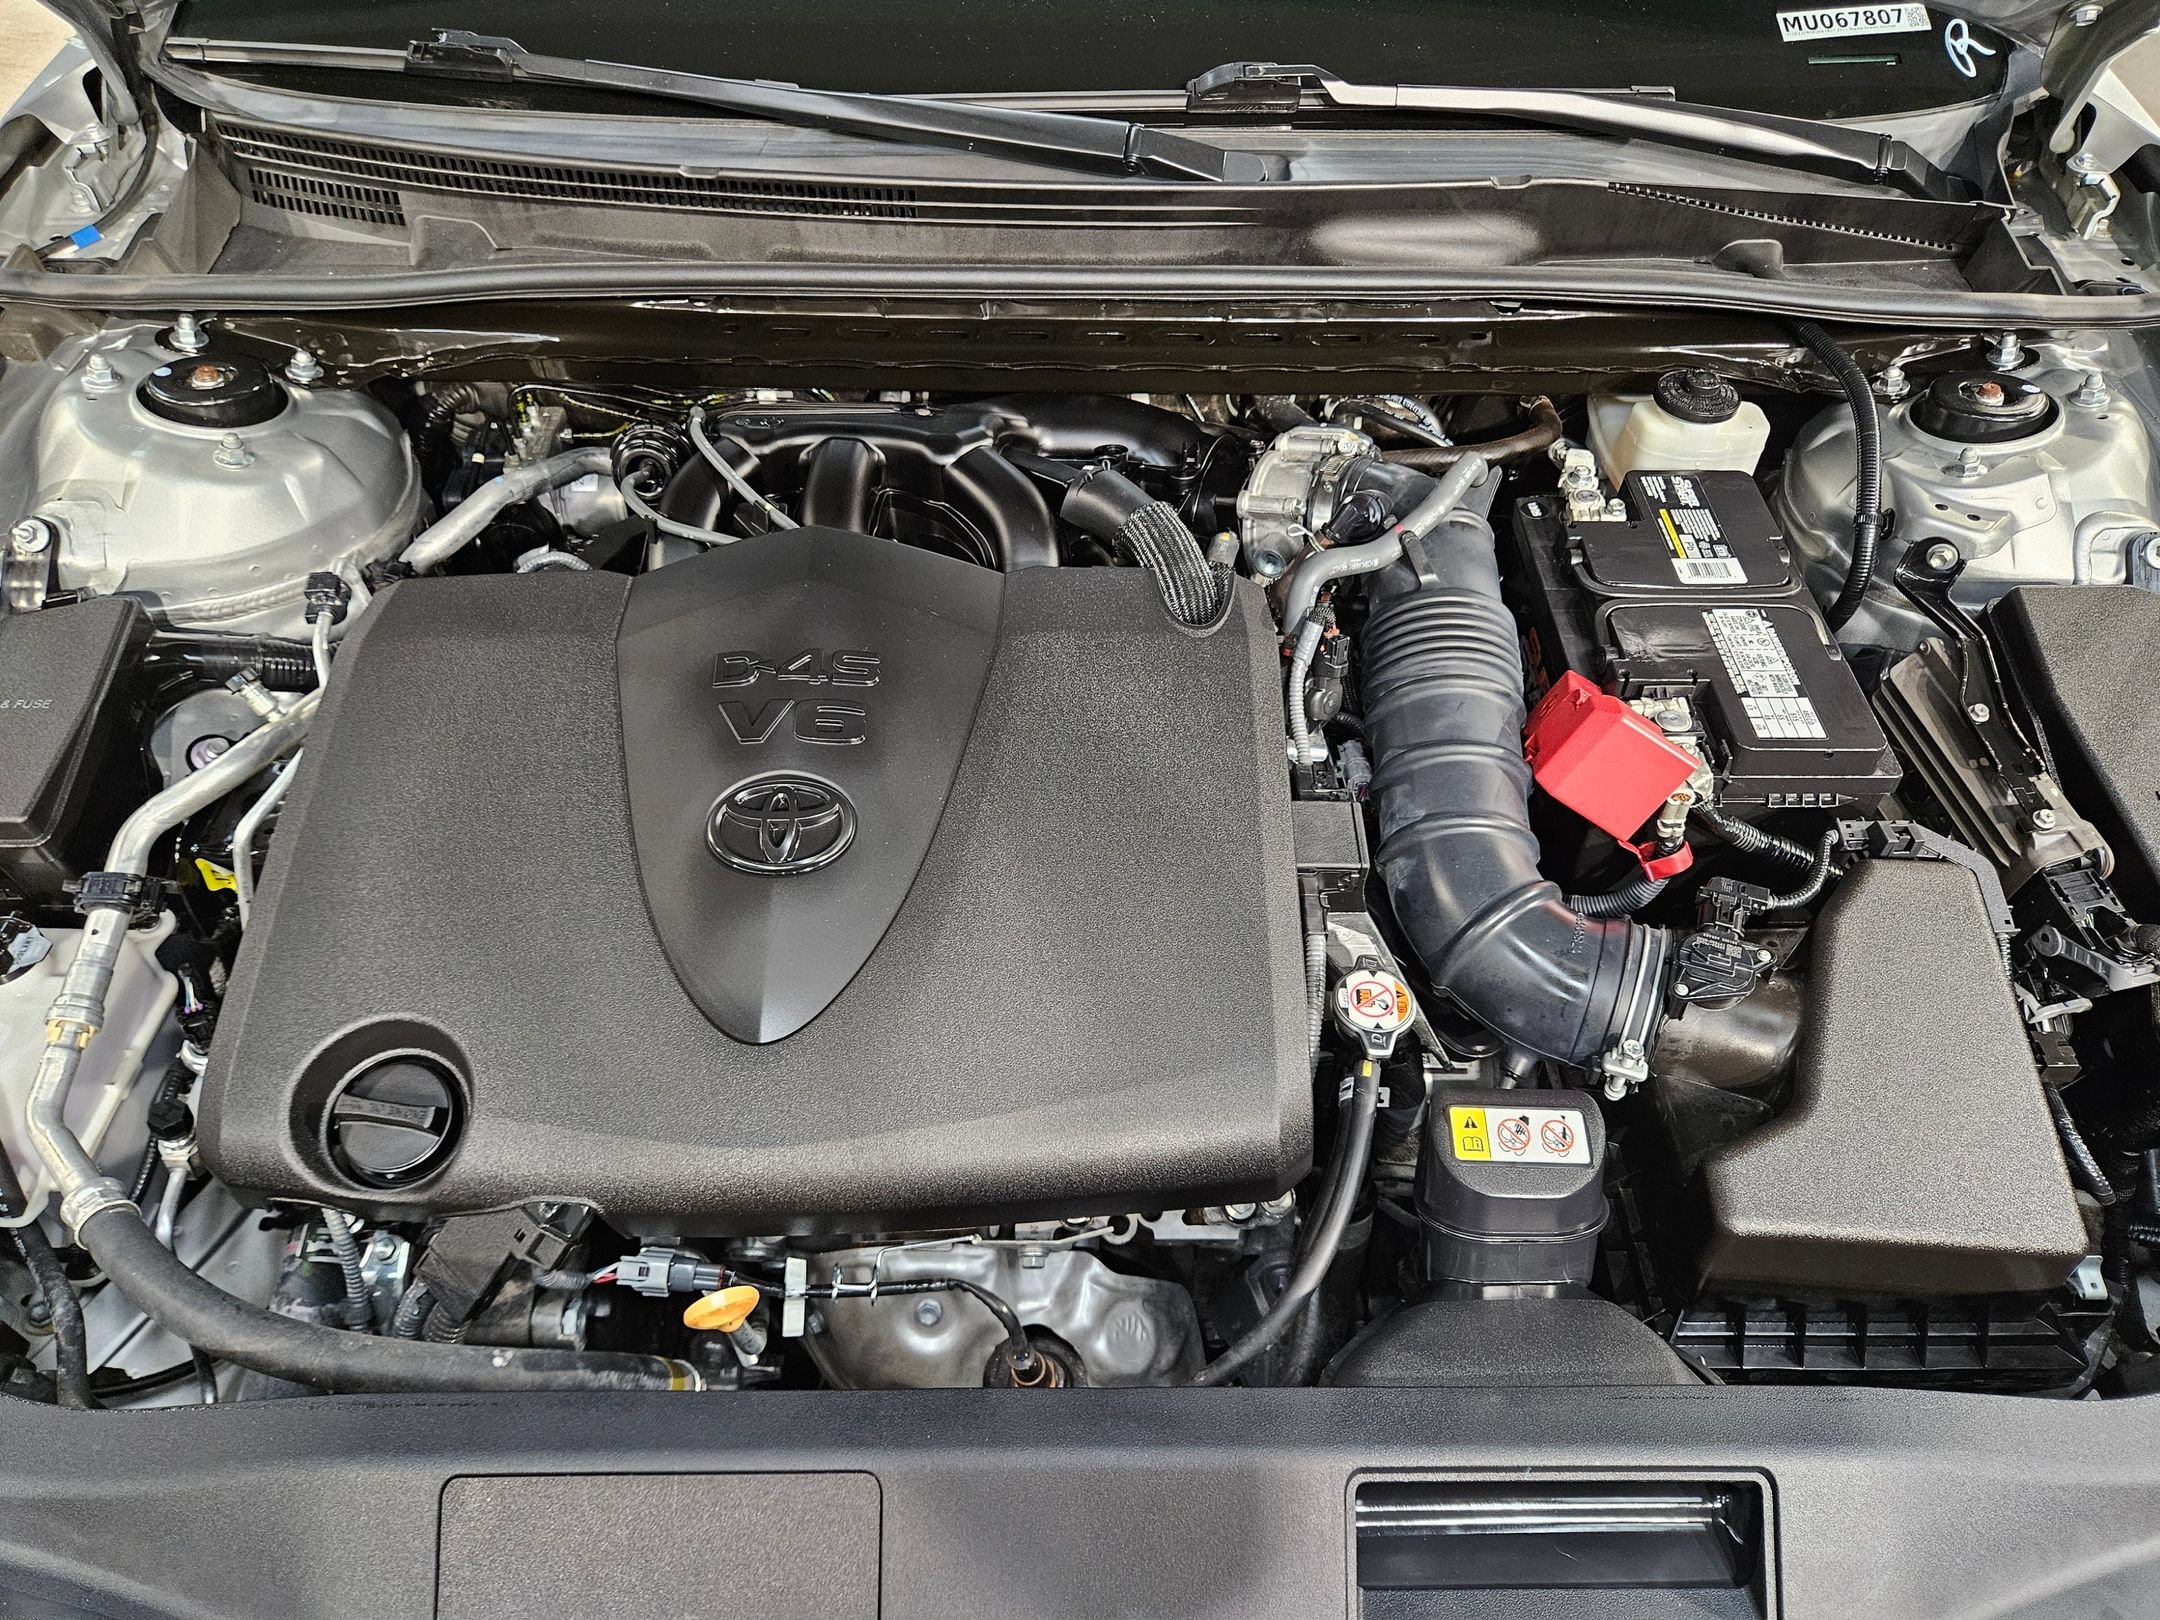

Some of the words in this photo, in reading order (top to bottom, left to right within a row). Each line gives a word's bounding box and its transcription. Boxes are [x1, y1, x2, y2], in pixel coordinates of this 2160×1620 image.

[1782, 8, 1903, 32] MU067807
[1685, 541, 1695, 551] Pb
[712, 649, 881, 688] D-4S
[13, 699, 53, 709] FUSE
[718, 699, 867, 745] V6
